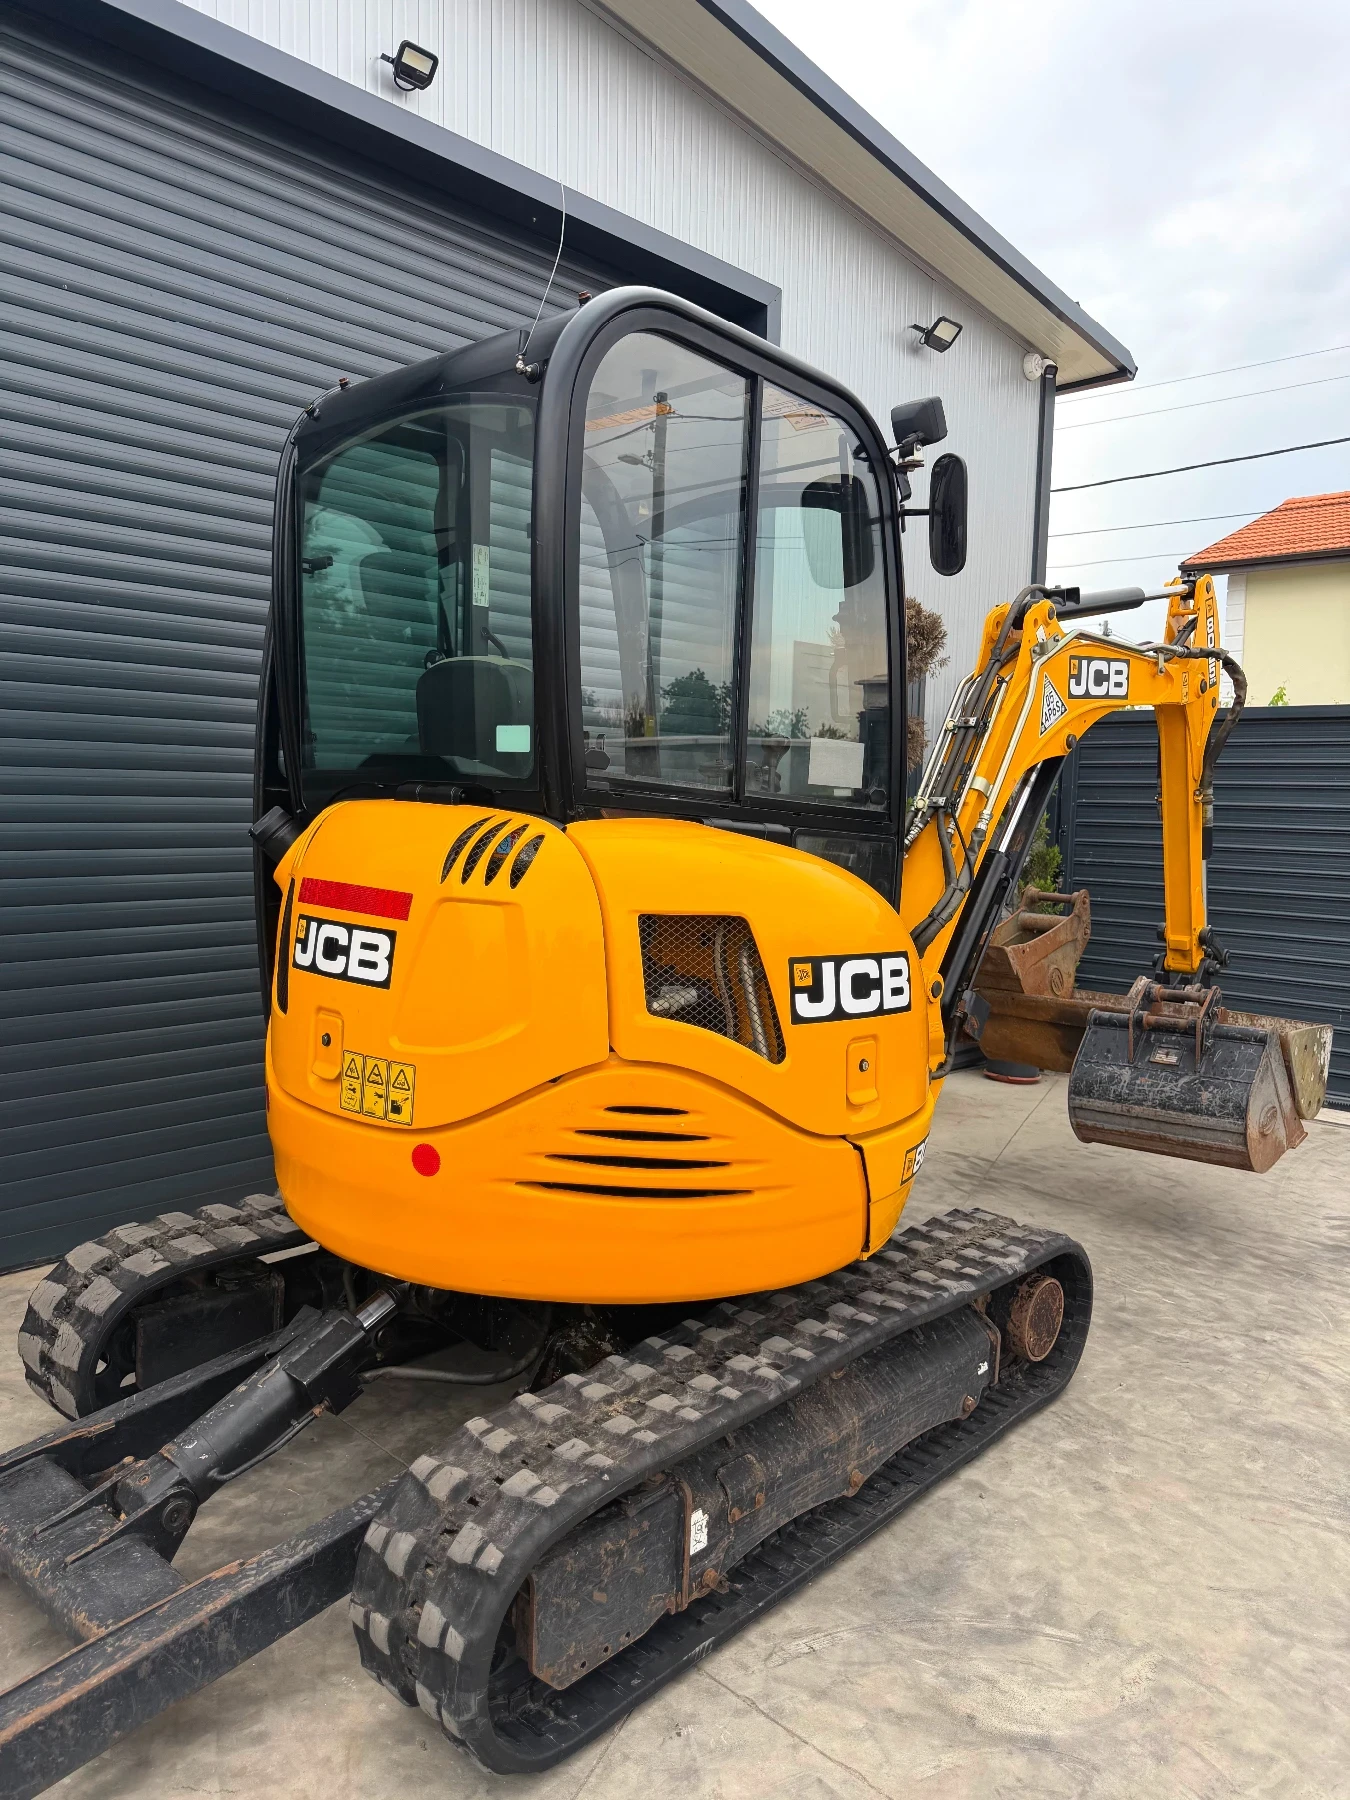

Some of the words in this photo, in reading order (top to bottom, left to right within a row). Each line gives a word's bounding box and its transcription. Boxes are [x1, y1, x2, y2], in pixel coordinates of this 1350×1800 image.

[1070, 660, 1128, 696] JCB
[294, 921, 391, 982] JCB
[795, 957, 910, 1017] JCB
